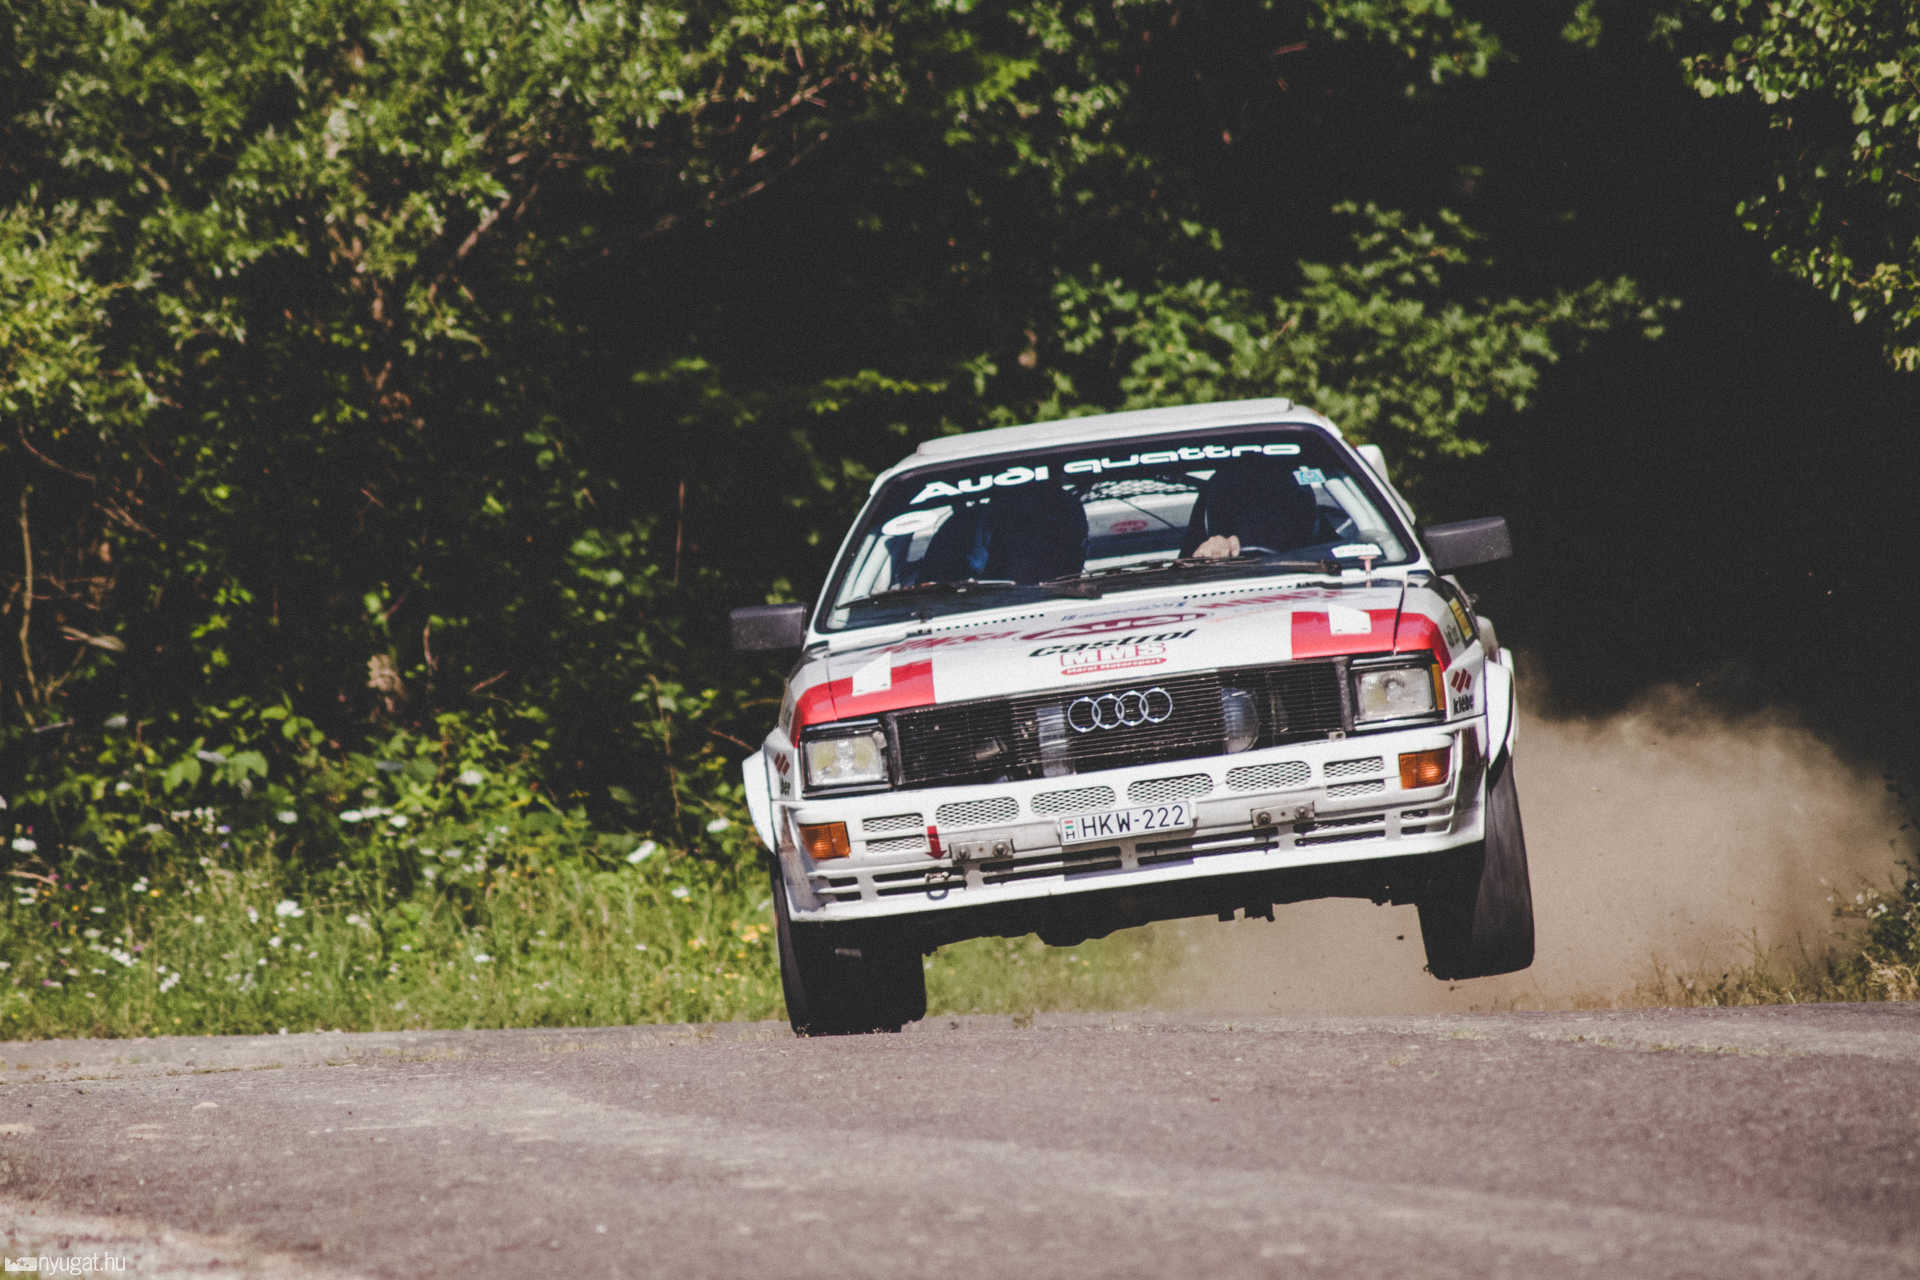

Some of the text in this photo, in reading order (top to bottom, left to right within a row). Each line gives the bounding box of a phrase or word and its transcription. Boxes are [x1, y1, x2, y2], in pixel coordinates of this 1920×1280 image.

[1063, 443, 1301, 474] quattro
[1028, 629, 1197, 657] Castrol
[1060, 643, 1166, 667] MMS
[1065, 804, 1185, 840] H HKW-222
